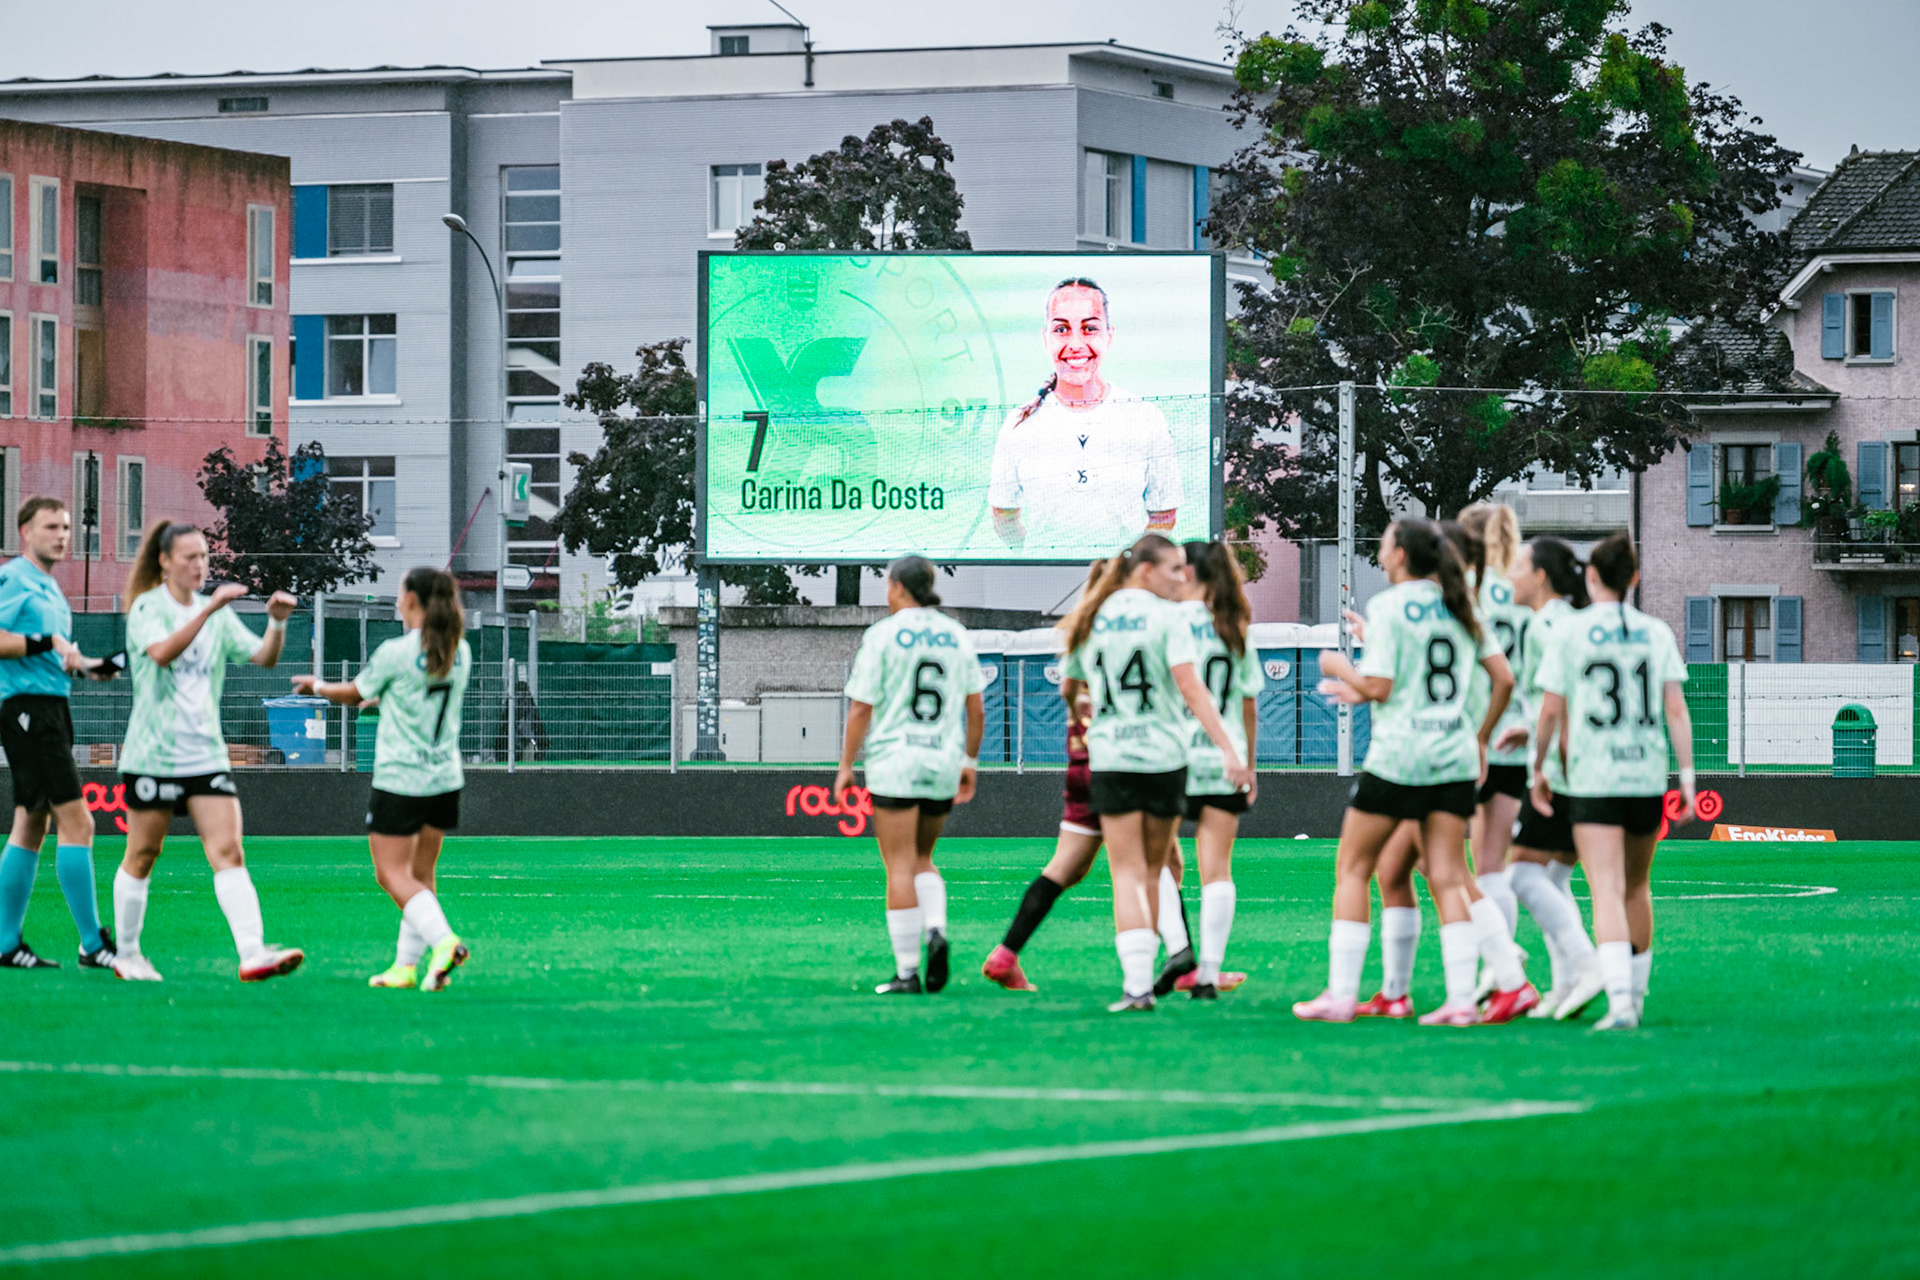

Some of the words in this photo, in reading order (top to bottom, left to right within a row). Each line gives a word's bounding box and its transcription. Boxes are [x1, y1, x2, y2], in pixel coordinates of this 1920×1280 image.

[742, 411, 769, 472] 7
[941, 397, 988, 434] 97
[741, 478, 822, 510] Carina
[831, 479, 862, 510] Da
[871, 478, 944, 510] Costa
[911, 660, 945, 722] 6
[1095, 649, 1153, 715] 14
[1426, 637, 1457, 703] 8
[1583, 659, 1656, 728] 31
[427, 683, 453, 744] 7
